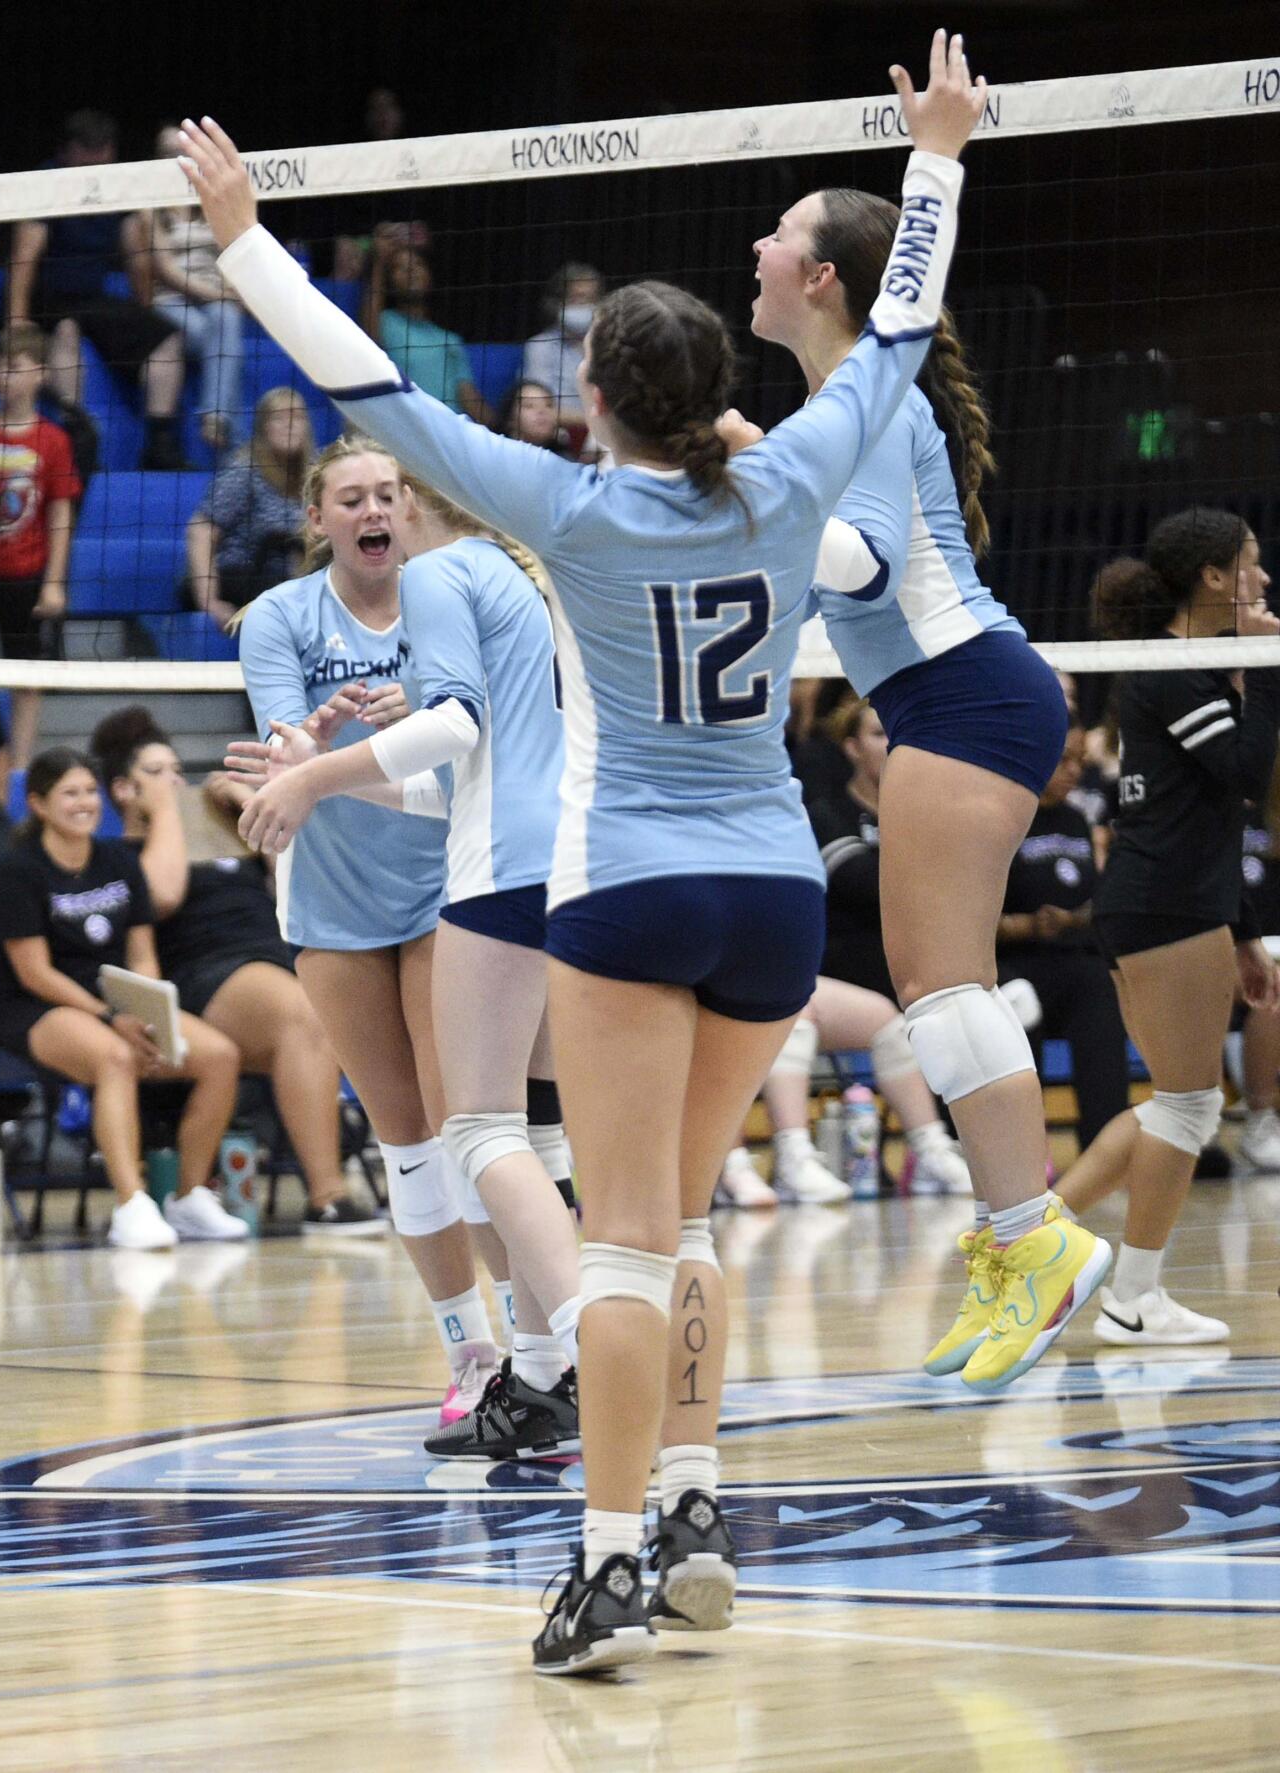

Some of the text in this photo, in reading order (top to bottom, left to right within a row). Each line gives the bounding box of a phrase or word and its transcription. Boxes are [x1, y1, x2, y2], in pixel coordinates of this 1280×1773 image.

[512, 127, 639, 169] HOCKINSON
[884, 195, 942, 303] HAWKS
[644, 568, 775, 724] 12
